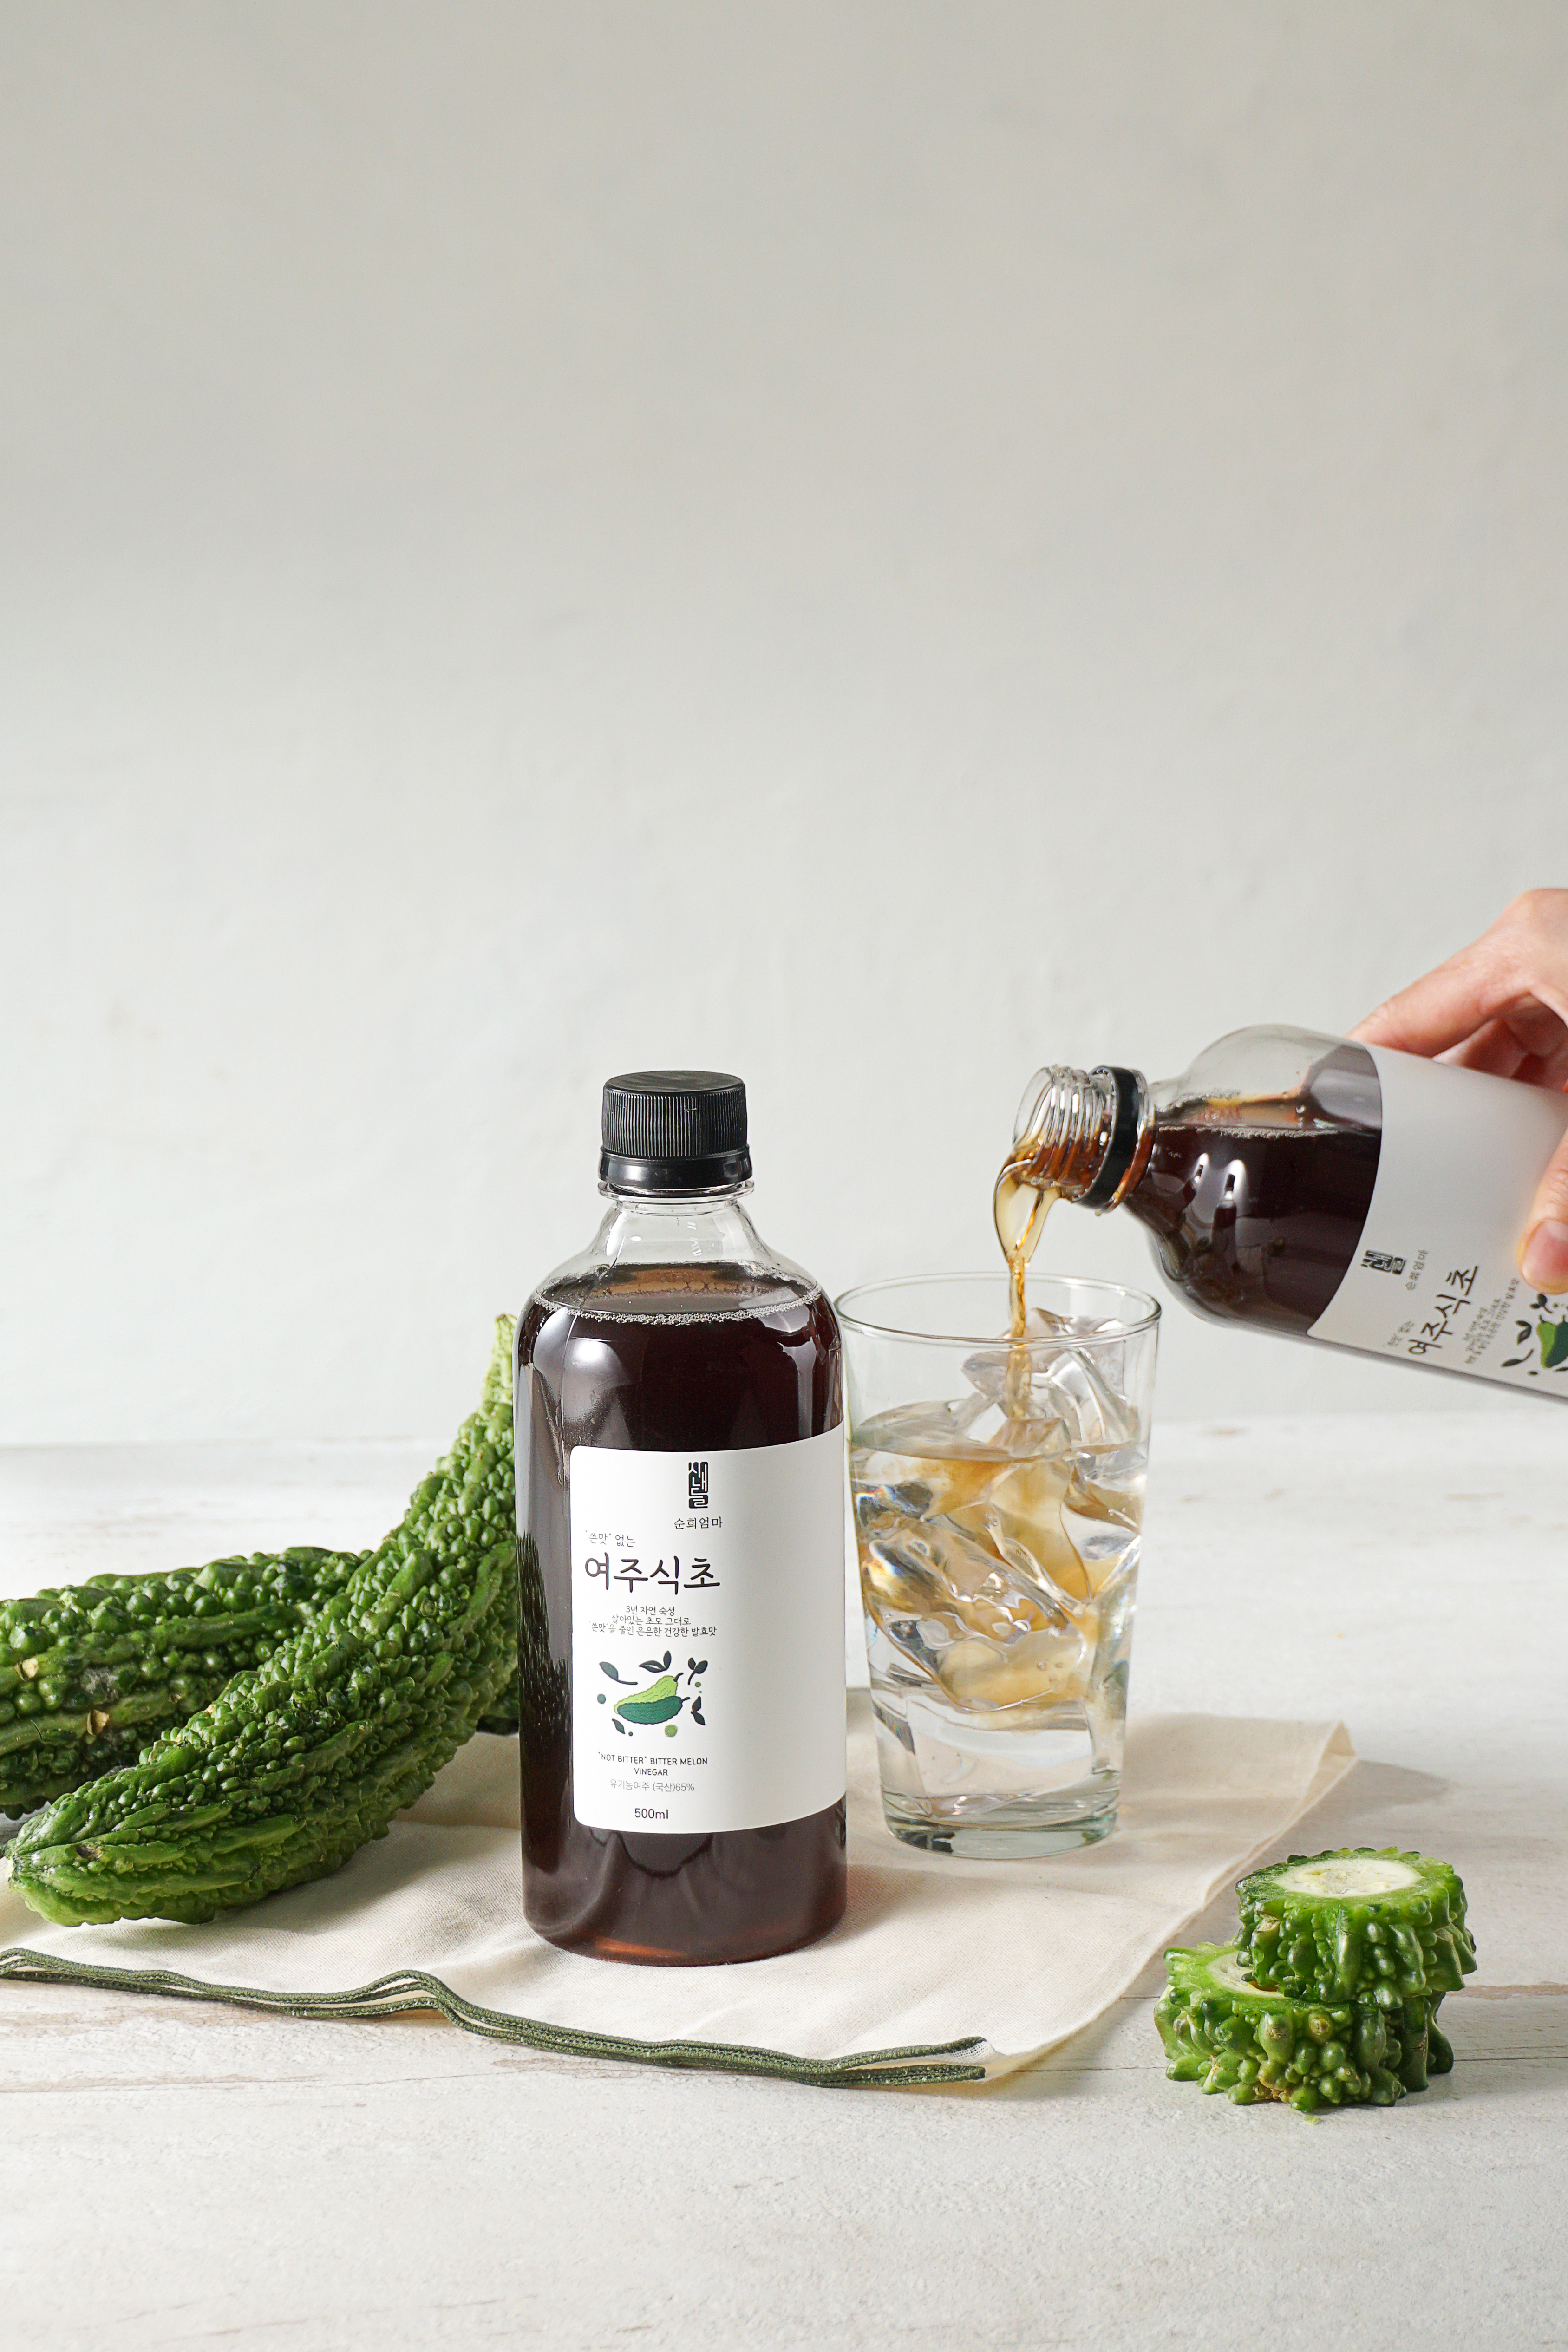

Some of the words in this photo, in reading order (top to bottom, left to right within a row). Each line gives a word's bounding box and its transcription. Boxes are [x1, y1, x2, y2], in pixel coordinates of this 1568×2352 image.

[1408, 1266, 1478, 1354] 여주식초
[674, 1516, 723, 1529] 순희엄마
[615, 1534, 635, 1548] 없는
[585, 1552, 720, 1595] 여주식초
[626, 1605, 637, 1615] 3년
[640, 1606, 656, 1615] 자연
[658, 1606, 675, 1616] 숙성
[611, 1614, 643, 1626] 살아있는
[665, 1616, 691, 1626] 그대로
[618, 1625, 634, 1635] 줄인
[636, 1627, 662, 1637] 은은한
[664, 1627, 689, 1637] 건강한
[691, 1626, 717, 1637] 발효맛
[634, 1767, 668, 1776] VINEGAR
[610, 1779, 650, 1791] 유기농여주
[653, 1782, 695, 1792] (국산)65%
[634, 1808, 669, 1820] 500ml
